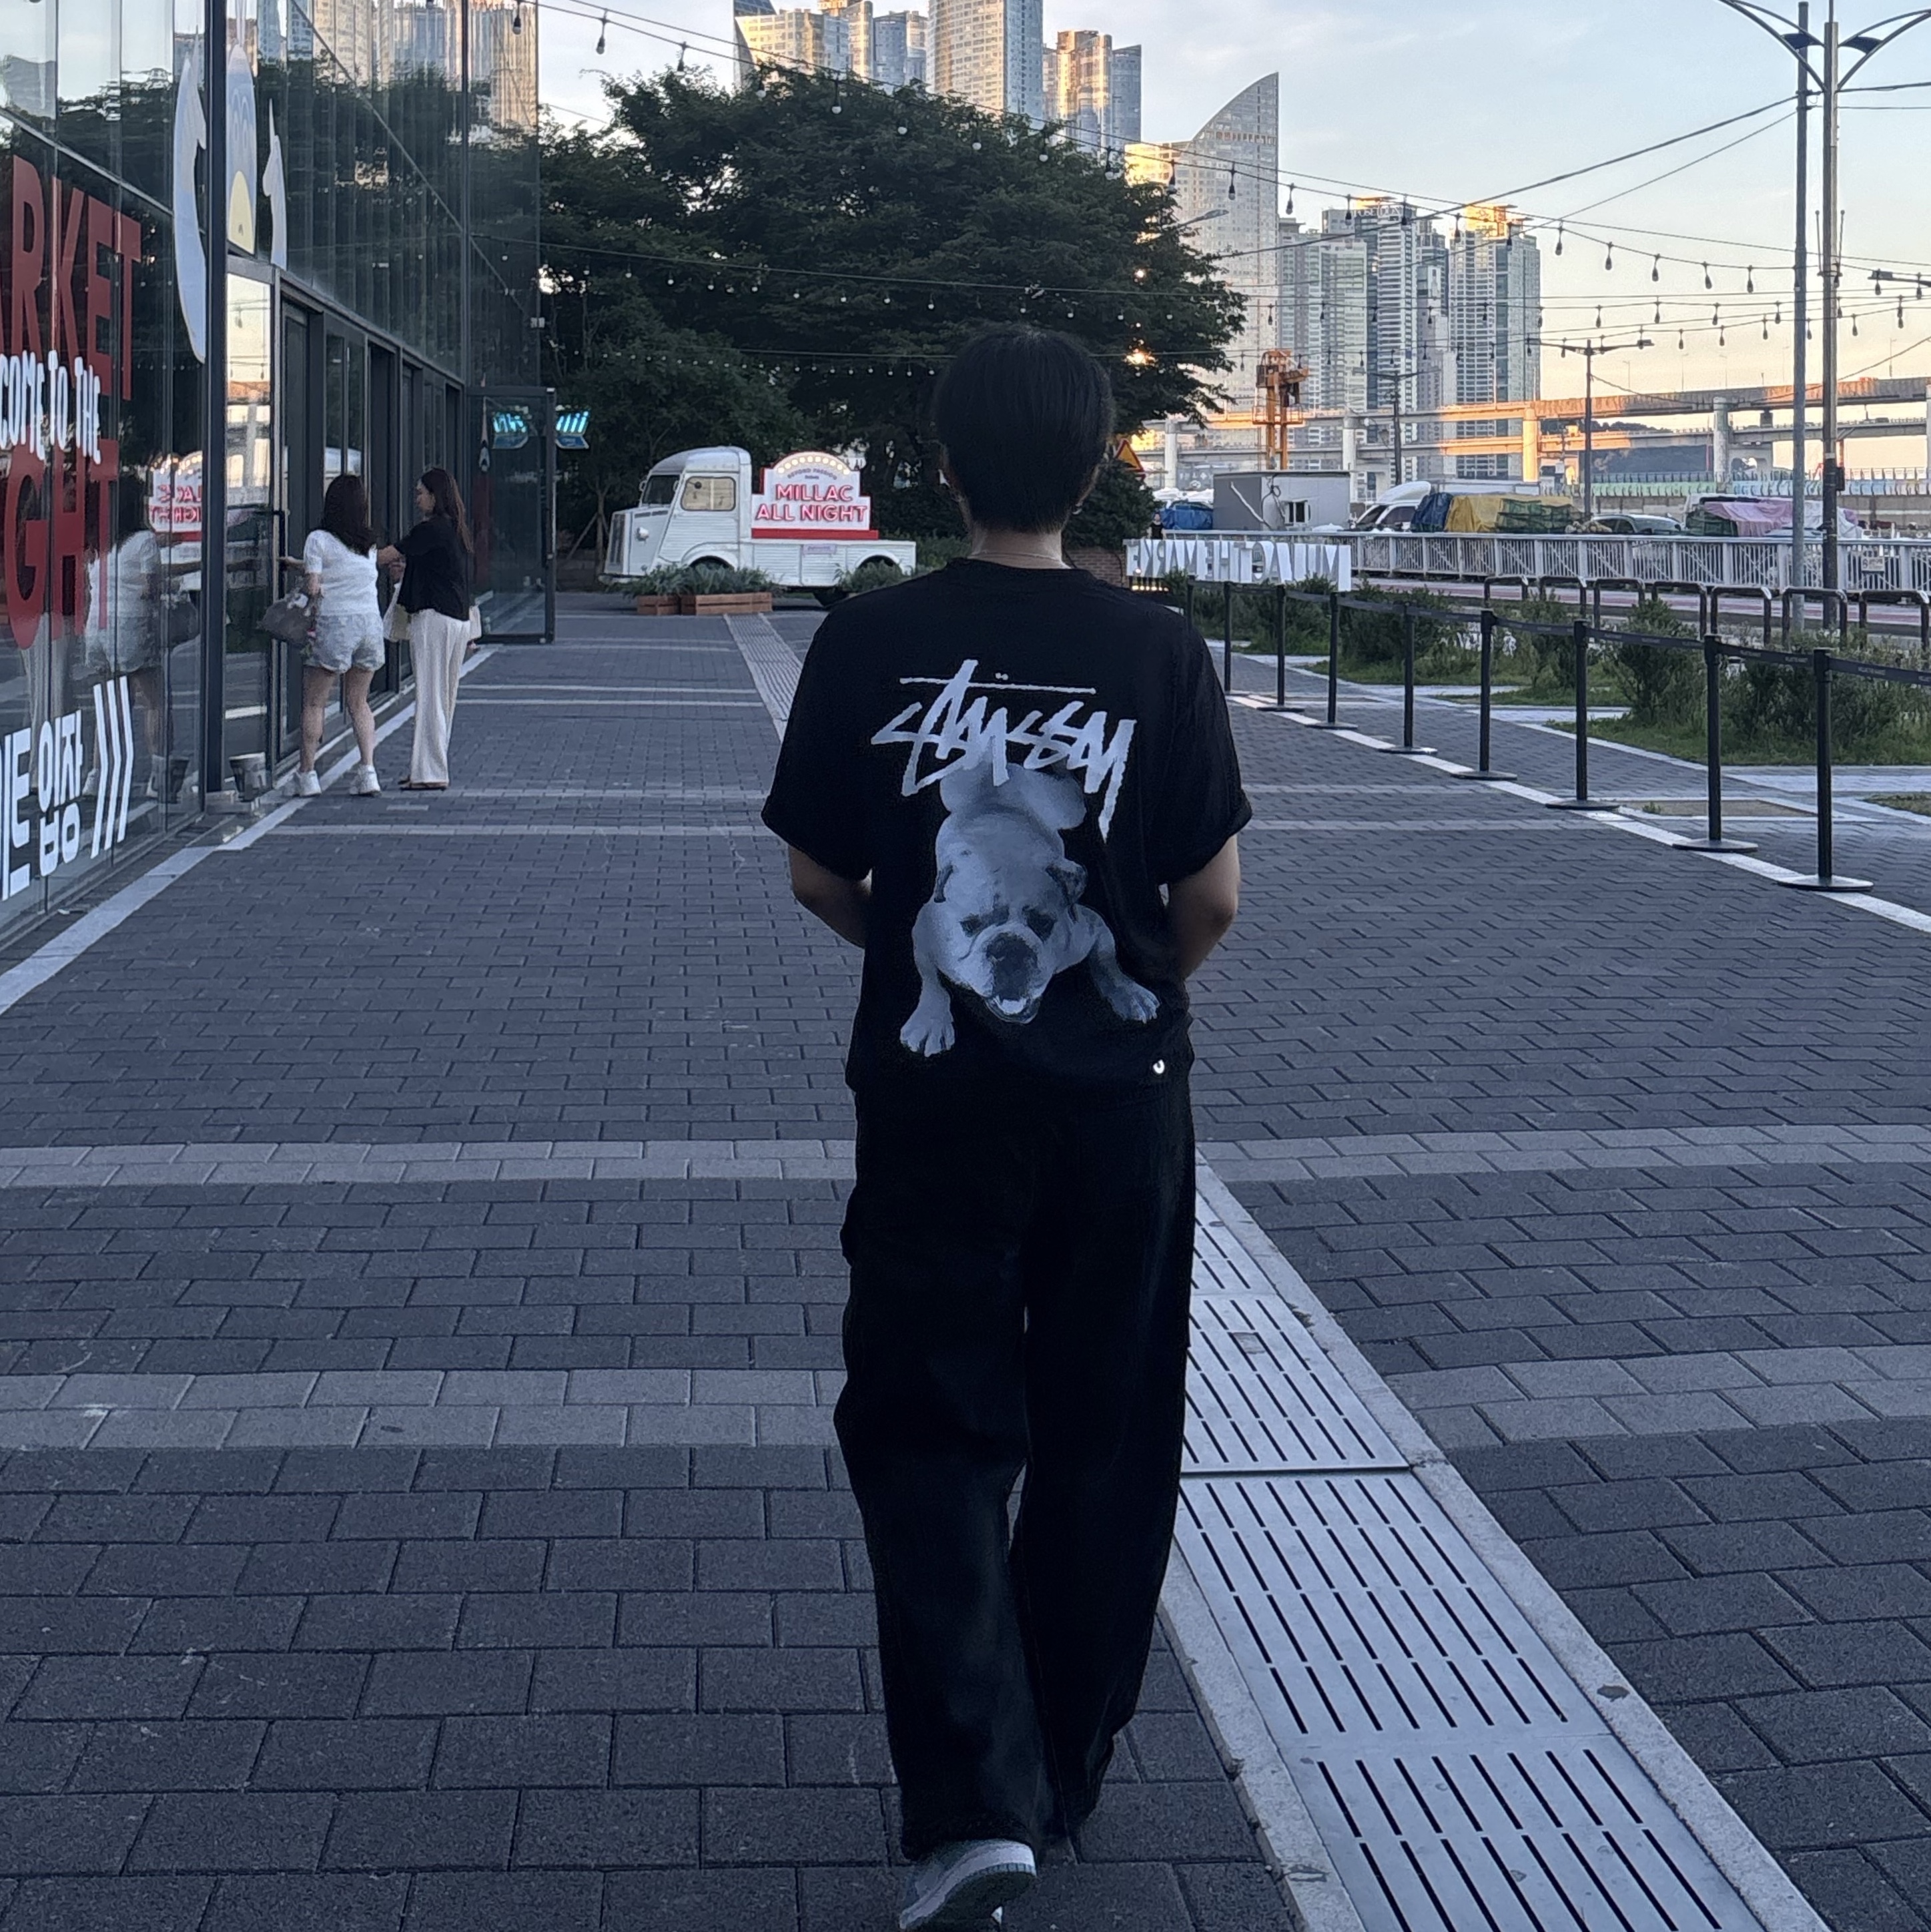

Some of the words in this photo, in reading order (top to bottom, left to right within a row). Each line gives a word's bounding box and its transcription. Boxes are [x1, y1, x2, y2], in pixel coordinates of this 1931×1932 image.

[0, 153, 141, 400] RKET
[47, 349, 67, 450] TO
[74, 356, 101, 464] THE
[755, 503, 795, 521] ALL
[800, 504, 867, 522] NIGHT
[775, 483, 853, 502] MILLAC
